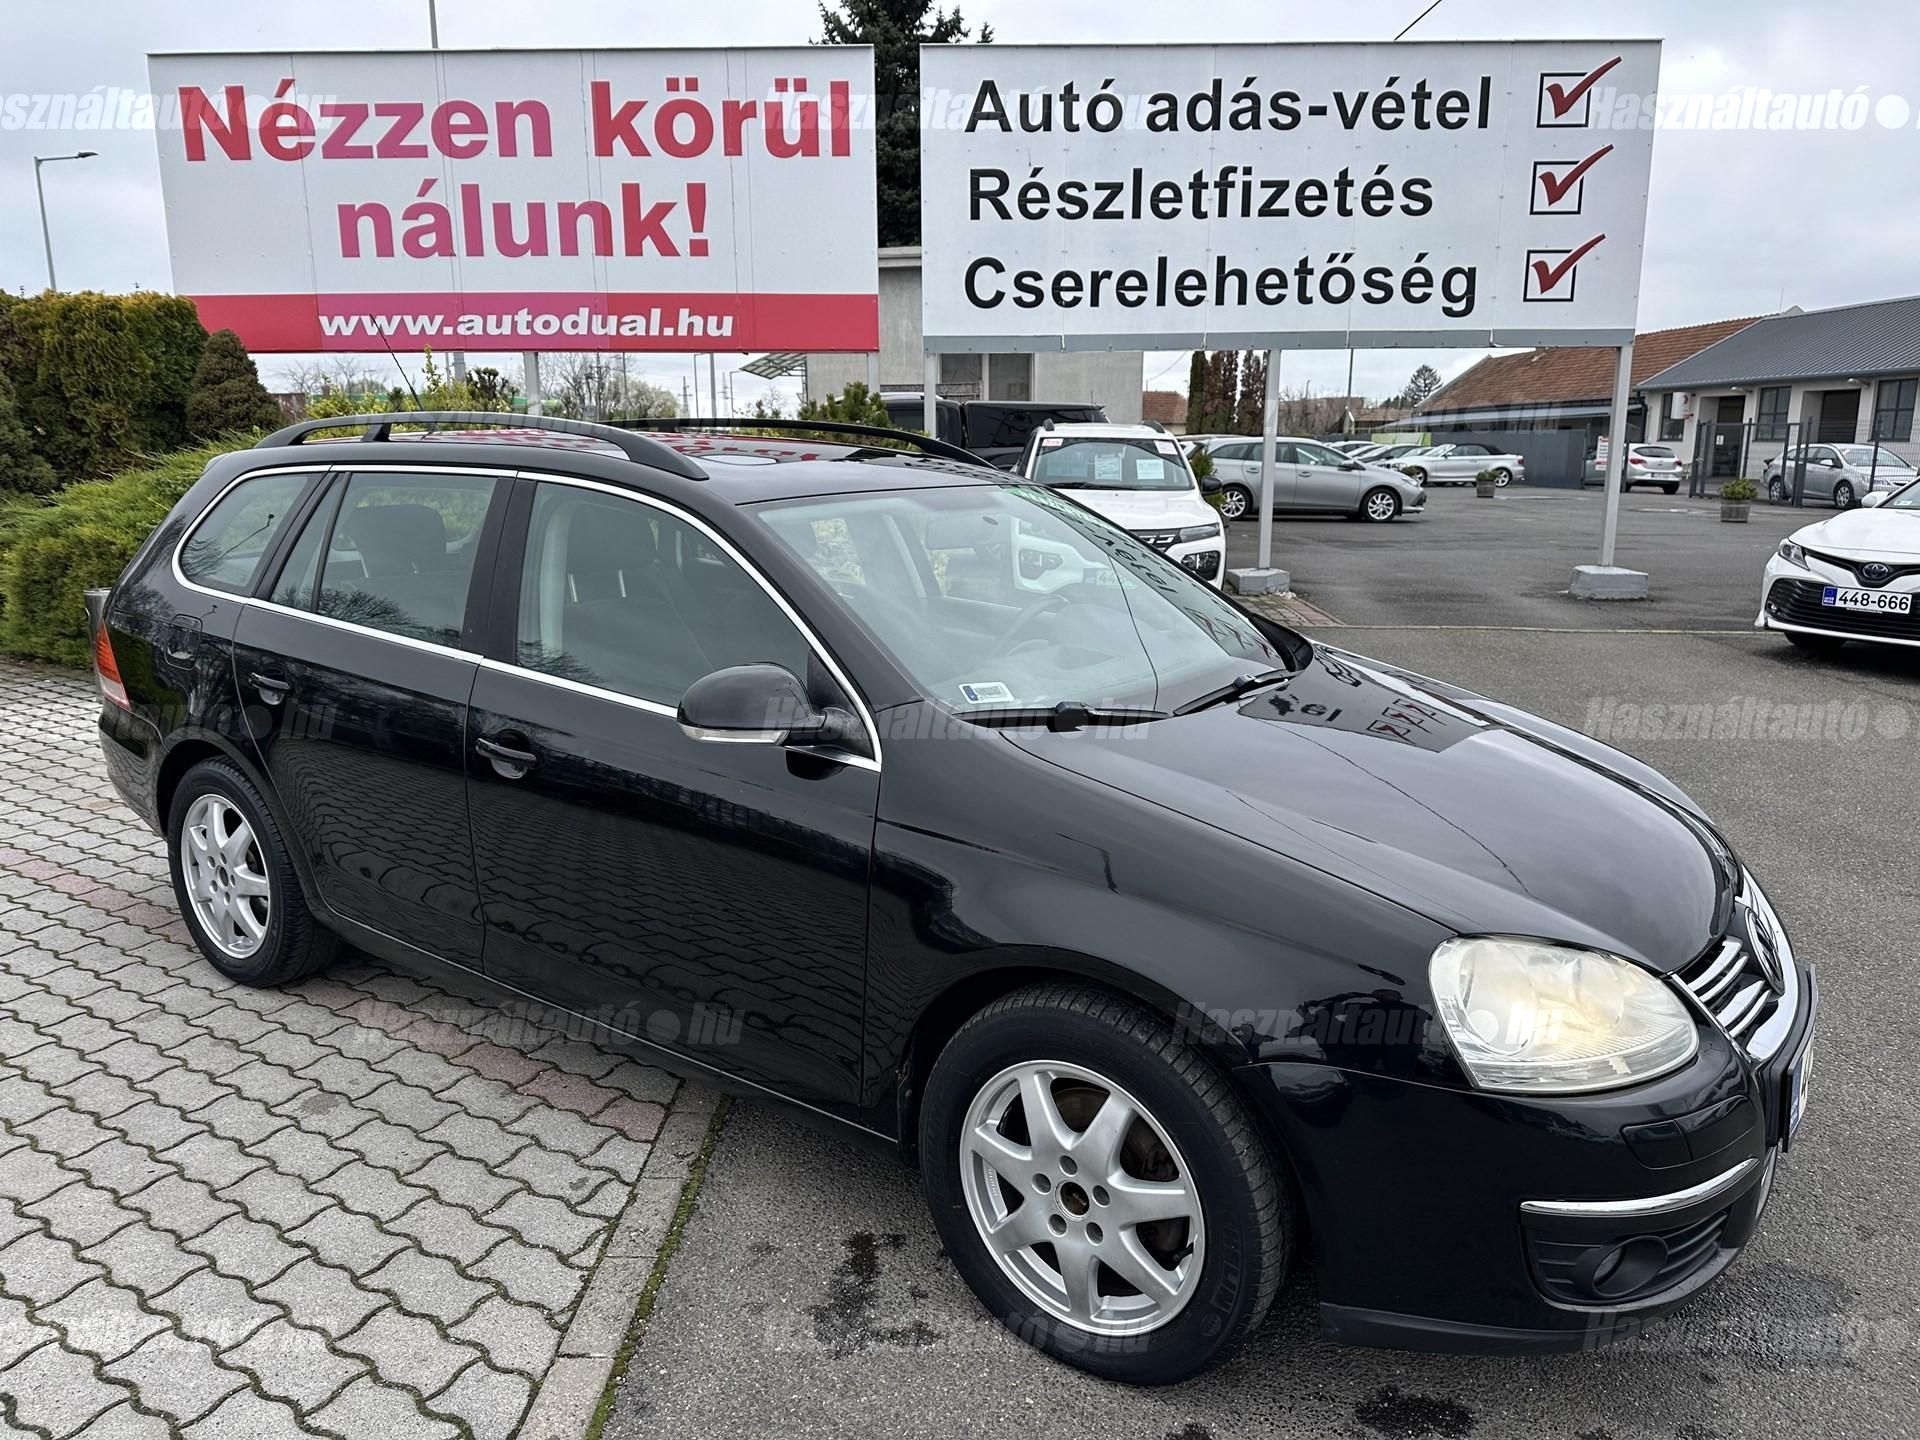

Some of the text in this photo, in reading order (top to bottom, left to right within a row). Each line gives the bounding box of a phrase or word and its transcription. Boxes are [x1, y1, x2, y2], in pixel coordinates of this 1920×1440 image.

[180, 78, 850, 161] Nézzen körül
[965, 77, 1490, 132] Autó adás-vétel
[339, 180, 708, 258] nálunk!
[970, 165, 1432, 220] Részletfizetés
[965, 253, 1476, 317] Cserelehetőség
[319, 307, 733, 338] www.autodual.hu
[1838, 591, 1910, 612] 448-666
